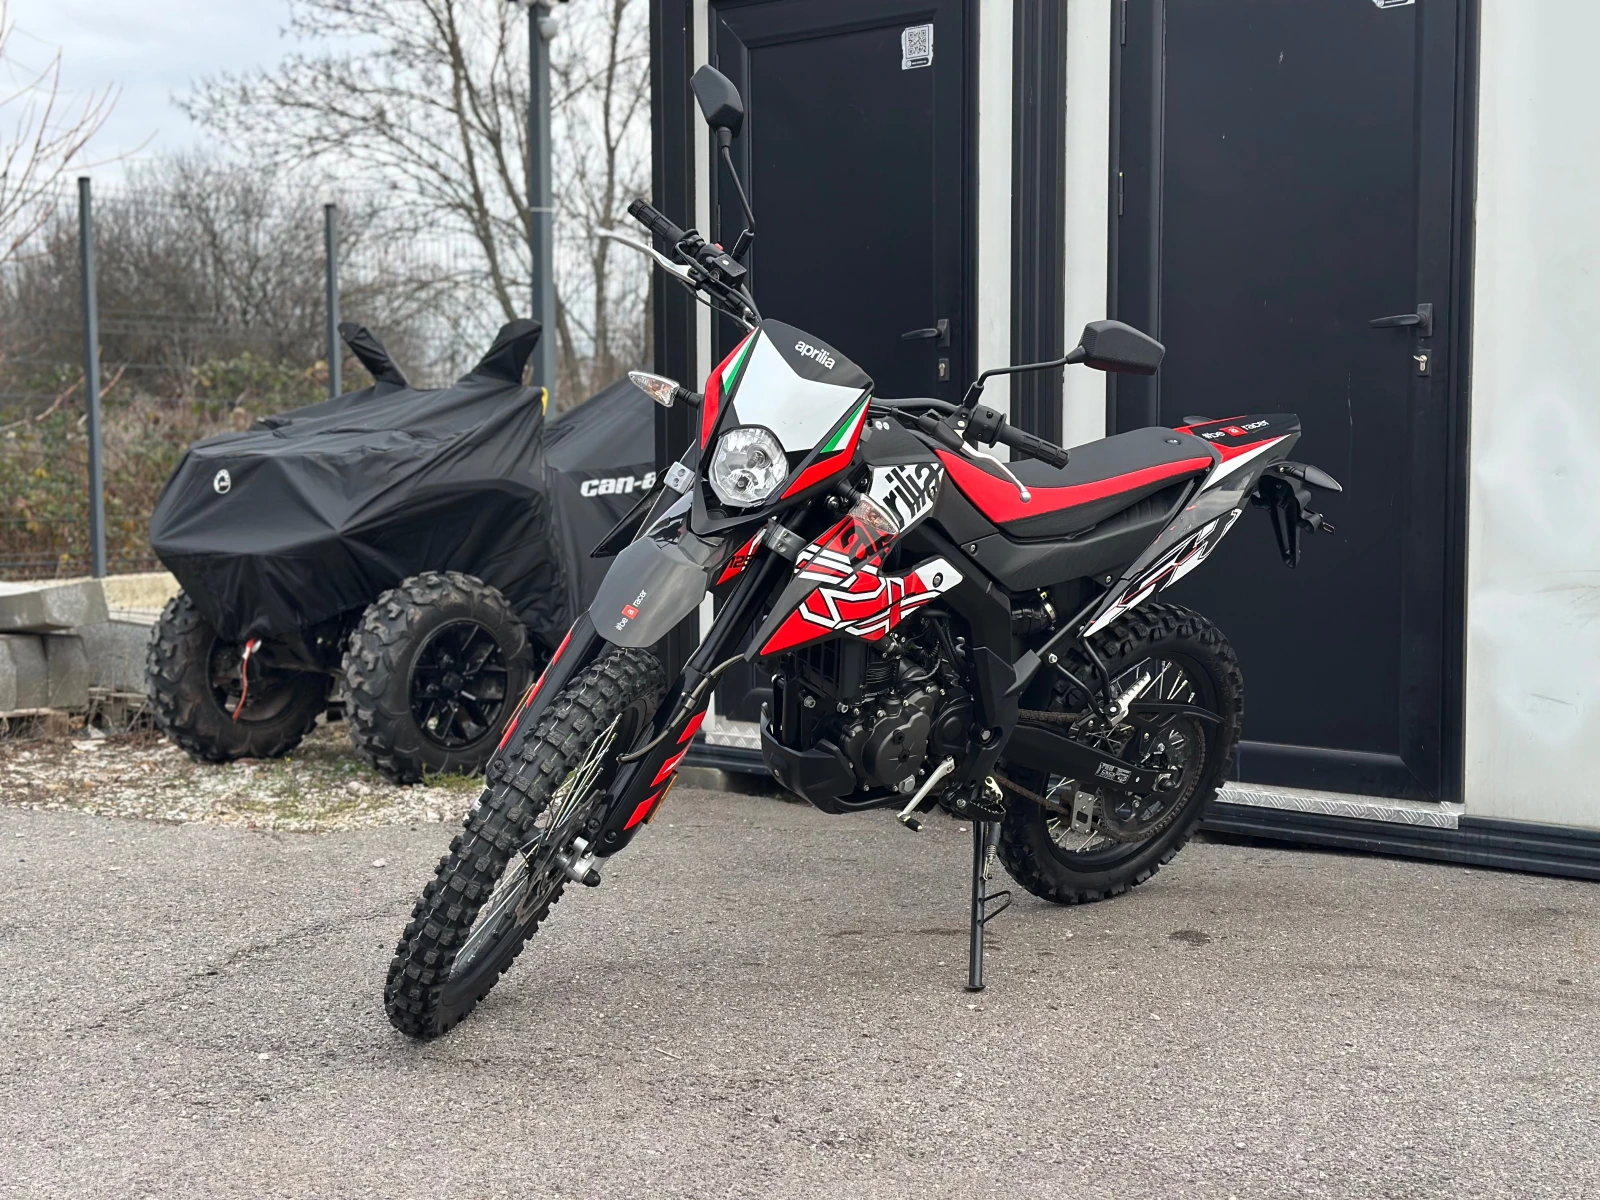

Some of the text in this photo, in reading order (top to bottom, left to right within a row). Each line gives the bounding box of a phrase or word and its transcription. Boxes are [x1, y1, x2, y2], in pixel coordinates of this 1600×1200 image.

[794, 340, 836, 370] aprilia
[615, 617, 628, 630] #be
[633, 589, 647, 607] racer
